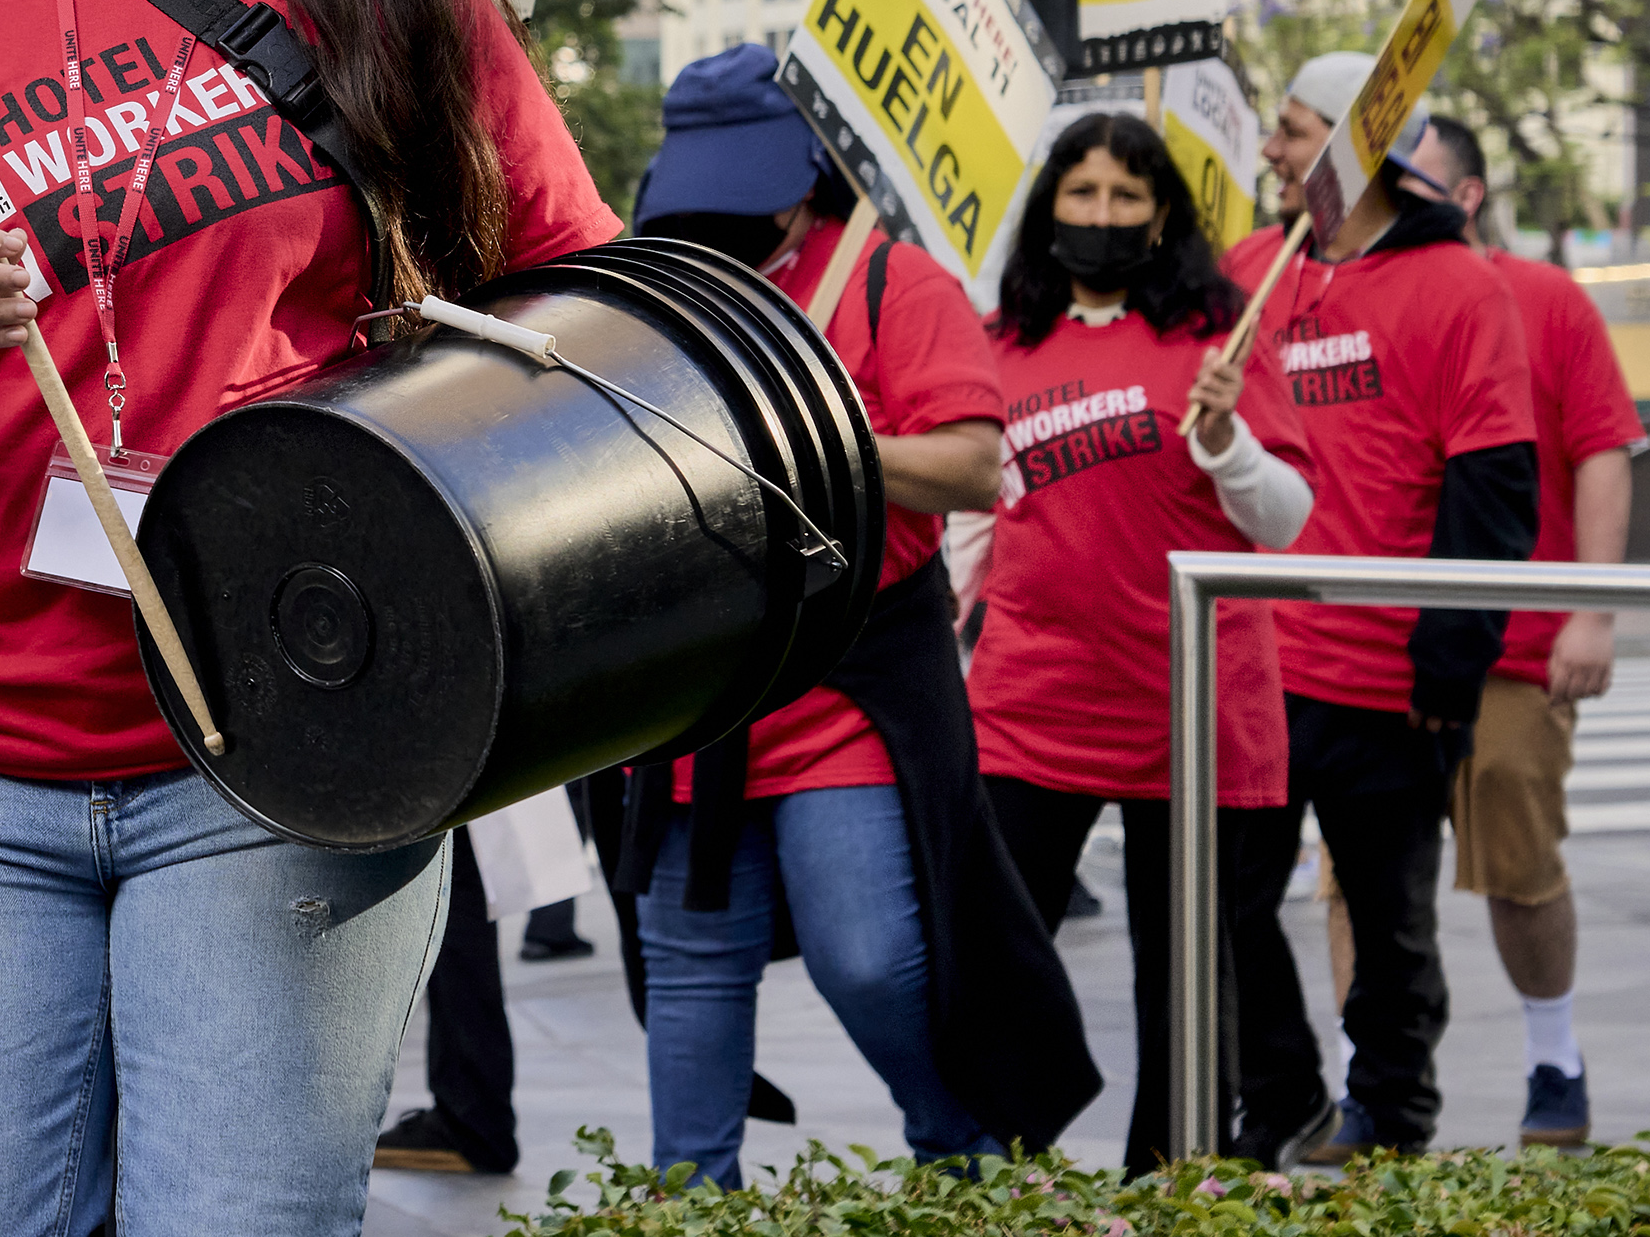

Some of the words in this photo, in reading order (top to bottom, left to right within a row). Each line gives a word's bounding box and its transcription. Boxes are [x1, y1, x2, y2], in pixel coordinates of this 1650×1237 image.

[901, 12, 964, 122] EN
[991, 57, 1010, 97] 11
[2, 63, 272, 196] WORKER
[57, 115, 337, 269] STRIK
[1006, 384, 1148, 452] WORKERS
[1007, 379, 1093, 424] HOTEL
[1025, 413, 1156, 486] STRIKE
